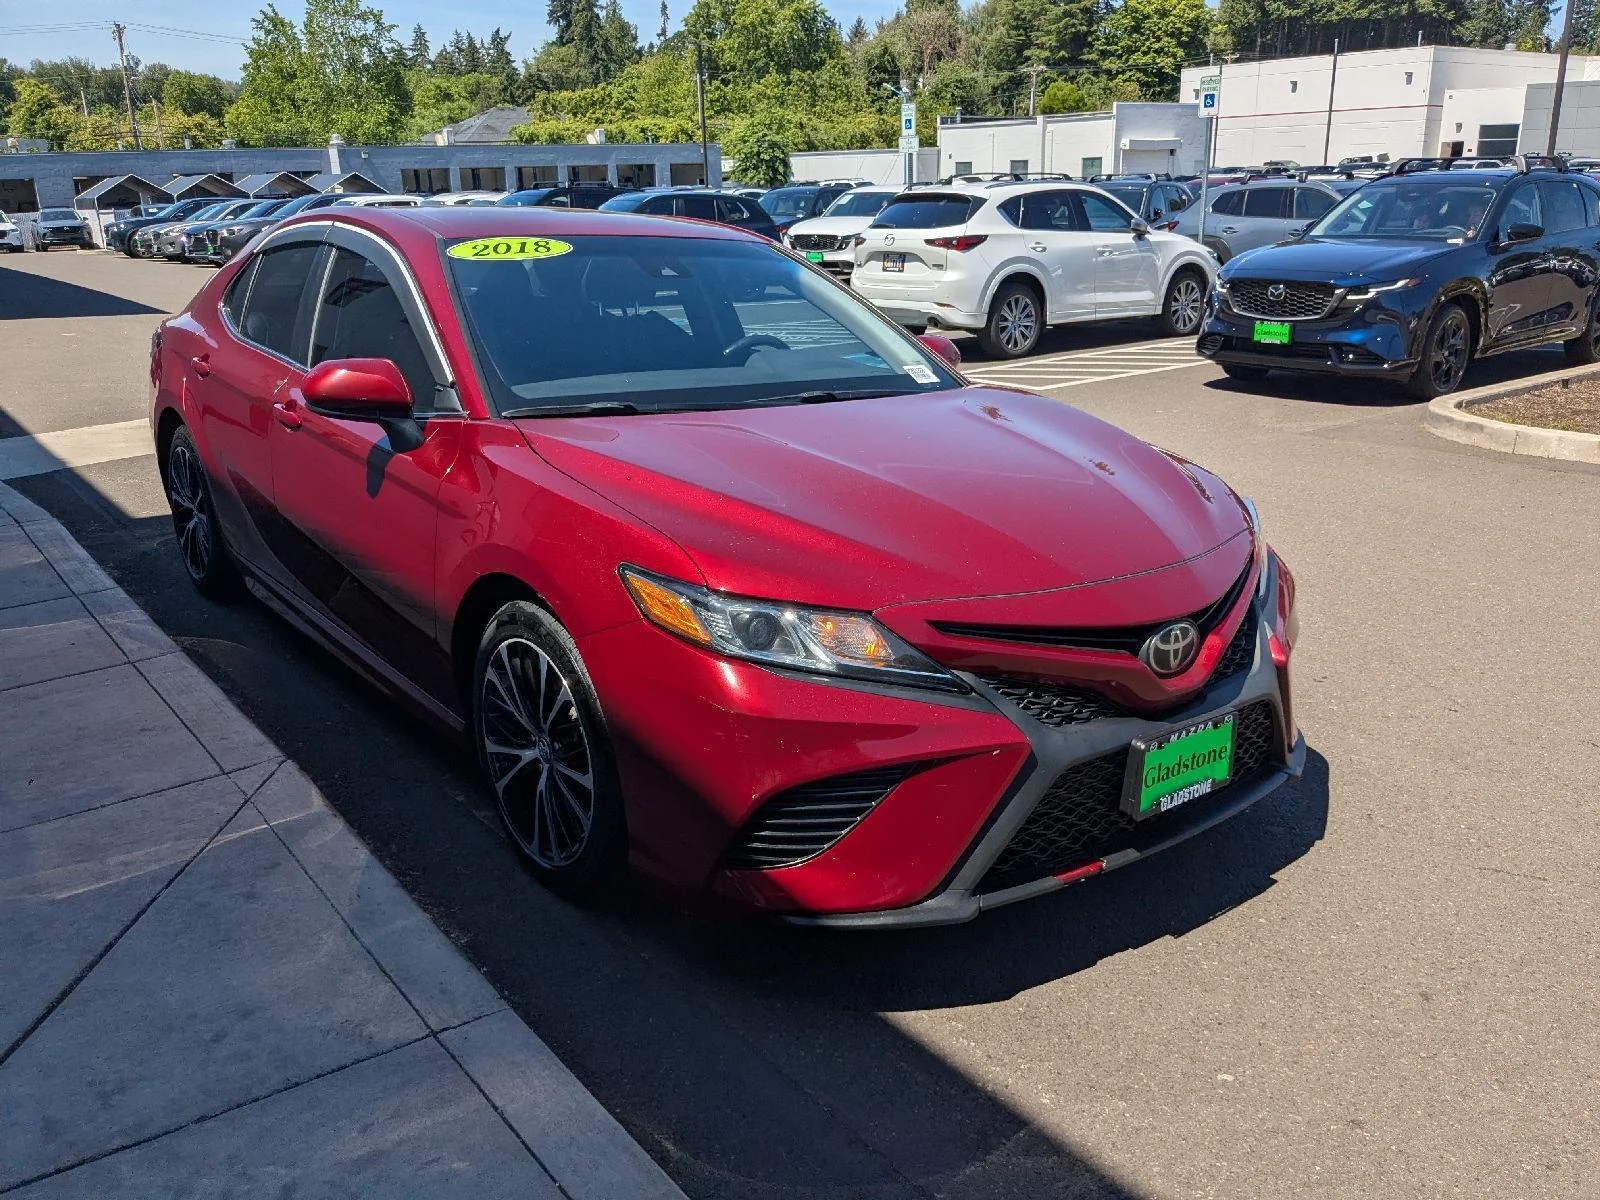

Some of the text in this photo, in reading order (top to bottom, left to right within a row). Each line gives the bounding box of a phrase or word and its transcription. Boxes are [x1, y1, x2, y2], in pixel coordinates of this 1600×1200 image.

[472, 241, 552, 257] 2018
[1256, 329, 1288, 338] Gladstone
[1169, 721, 1213, 742] MAZDA
[1144, 745, 1228, 789] Gladstone
[1160, 778, 1212, 811] GLADSTONE
